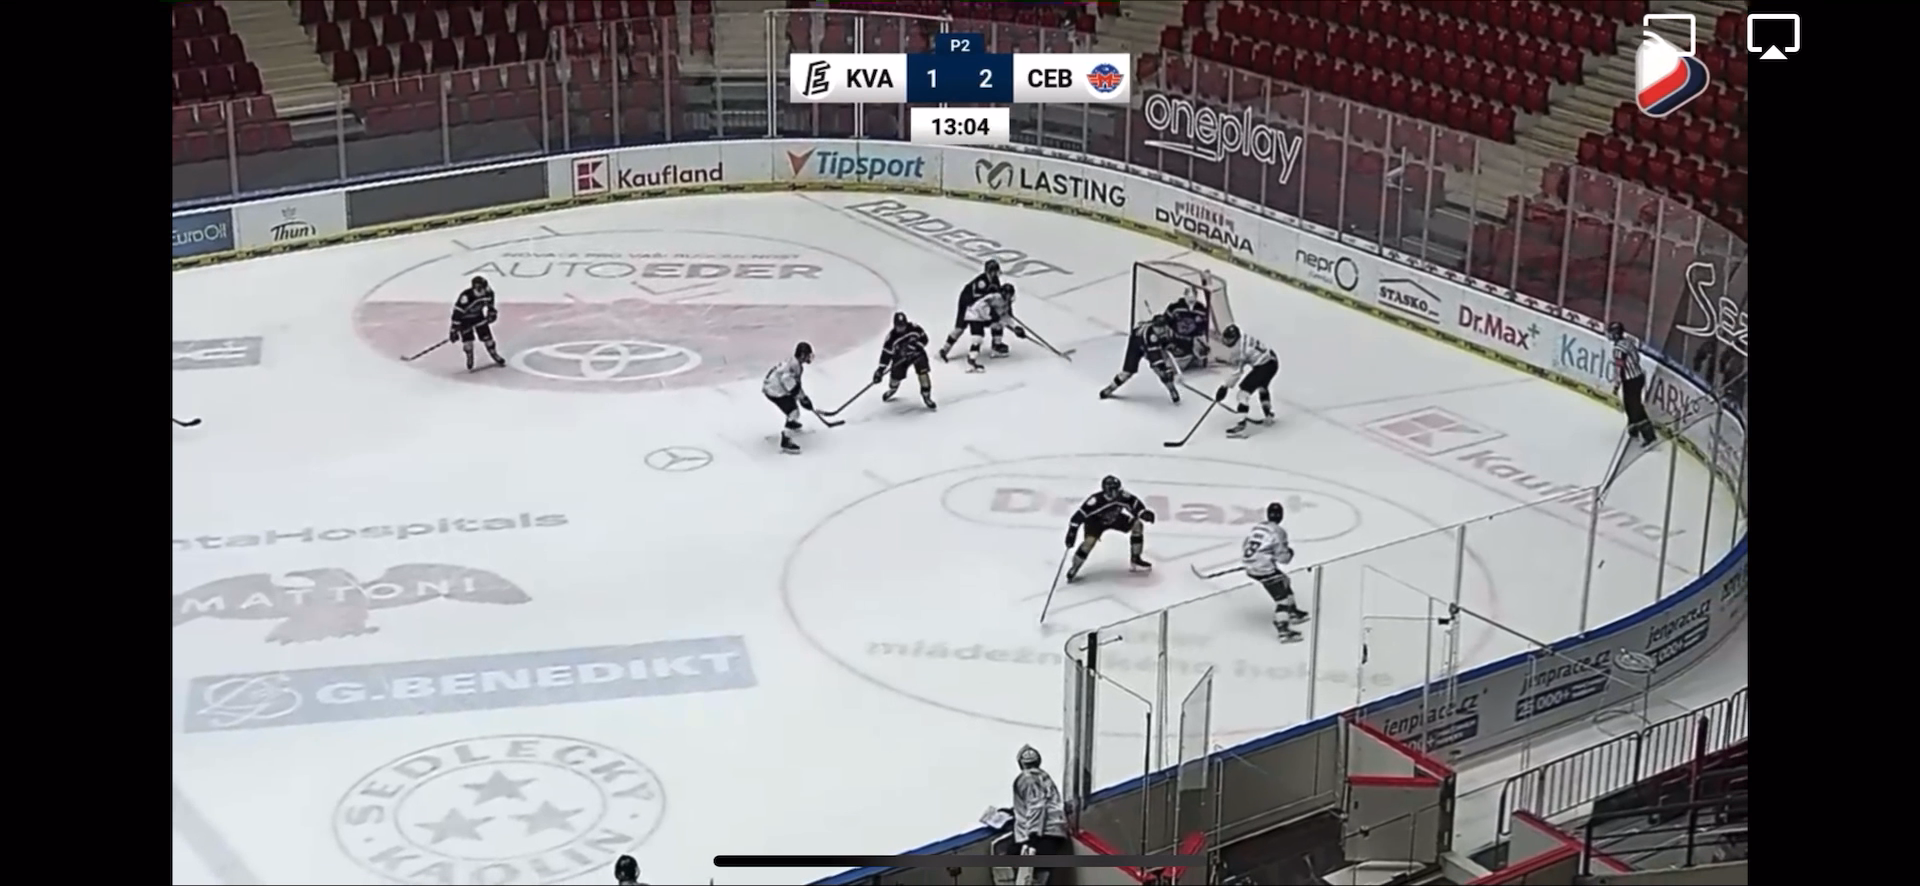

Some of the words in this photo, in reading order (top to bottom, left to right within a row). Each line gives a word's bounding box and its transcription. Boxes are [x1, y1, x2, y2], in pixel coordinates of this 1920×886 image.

[1144, 93, 1302, 185] oneplay
[618, 161, 723, 189] Kaufland
[816, 150, 925, 180] Tipsport
[1020, 167, 1127, 208] LASTING
[270, 220, 316, 242] Thun
[1155, 207, 1254, 255] DVORANA
[1561, 333, 1618, 382] Karlo
[180, 577, 476, 615] MATTONI
[316, 651, 739, 705] G.BENEDIKT
[367, 828, 634, 884] KAOLIN
